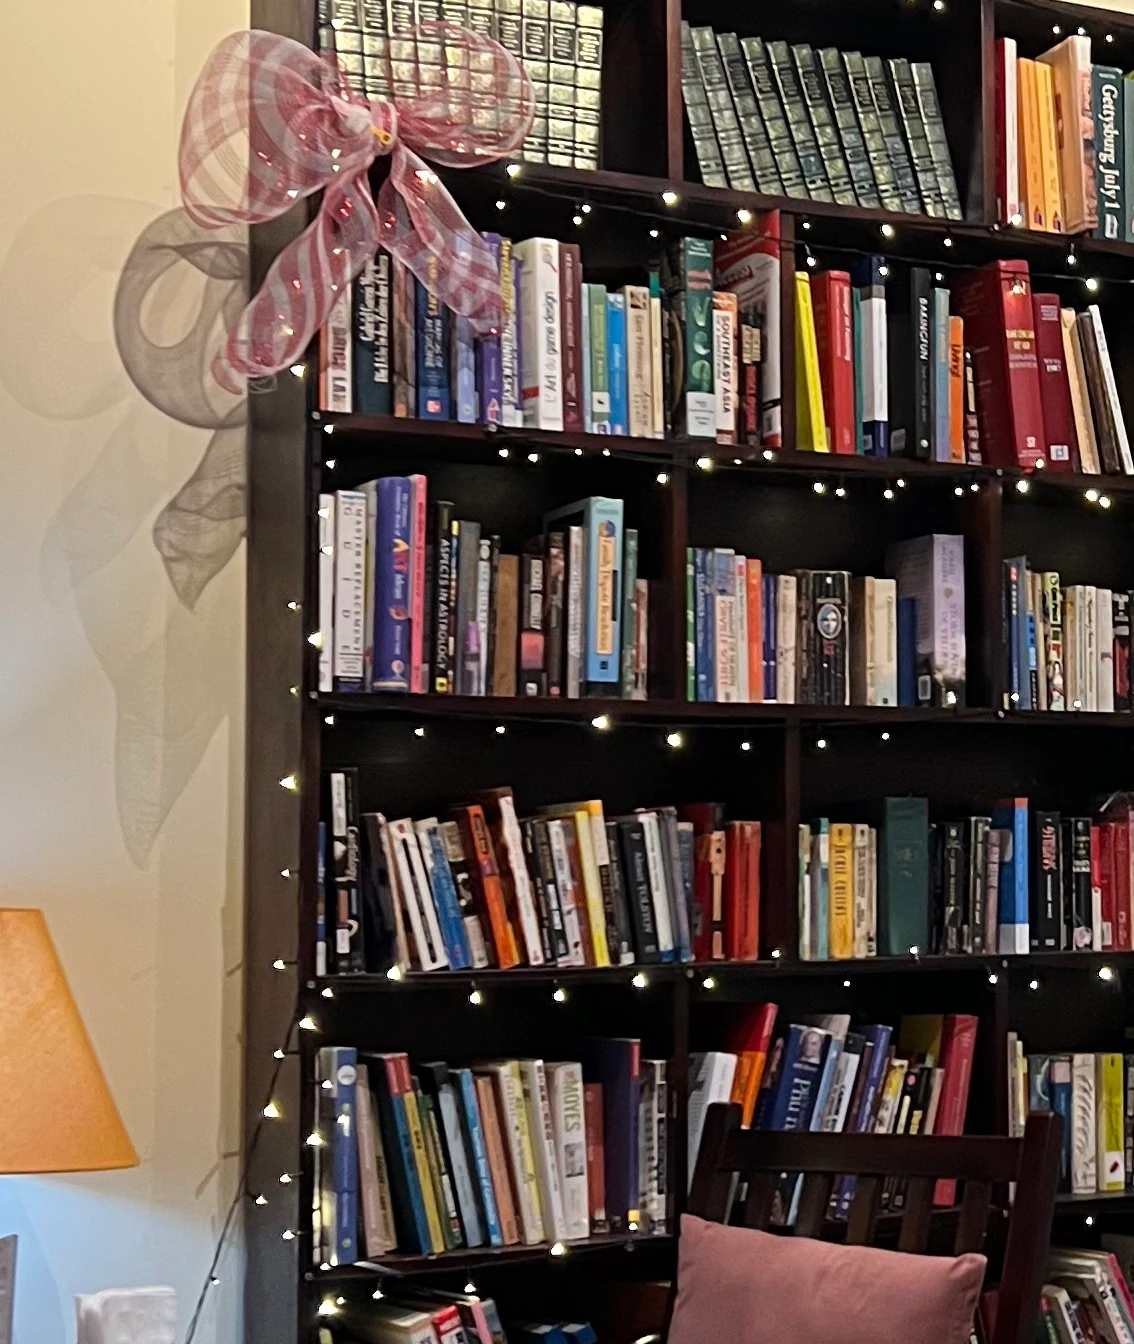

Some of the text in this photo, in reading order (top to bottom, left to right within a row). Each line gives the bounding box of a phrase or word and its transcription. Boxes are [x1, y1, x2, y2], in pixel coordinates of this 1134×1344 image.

[1098, 84, 1120, 209] Gettysburg July 1
[542, 291, 557, 324] design
[332, 326, 347, 371] BRICK
[547, 327, 557, 355] game
[634, 336, 647, 380] Fleming
[722, 315, 731, 413] SOUTHEAST ASIA
[503, 376, 514, 401] SKY
[437, 539, 450, 669] ASPECTS IN ASTROLOGY
[564, 1079, 581, 1133] MOYES
